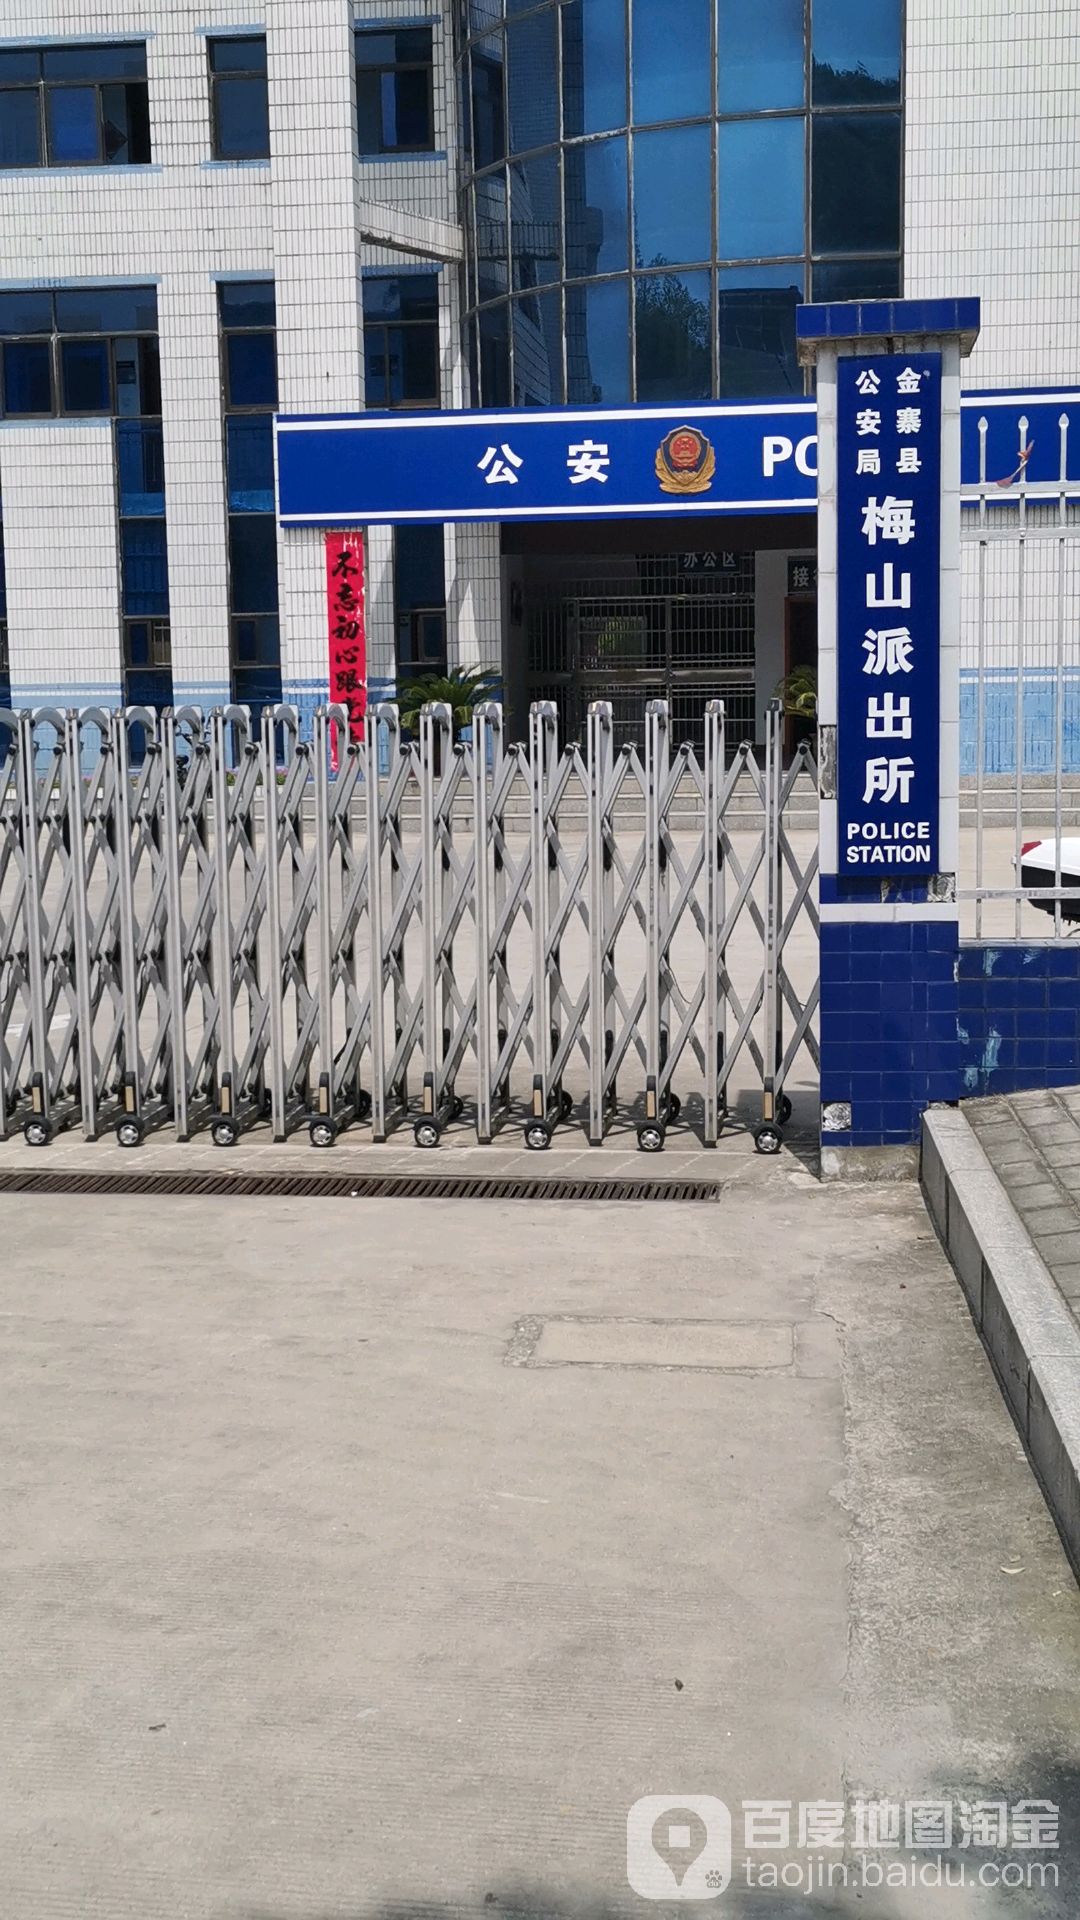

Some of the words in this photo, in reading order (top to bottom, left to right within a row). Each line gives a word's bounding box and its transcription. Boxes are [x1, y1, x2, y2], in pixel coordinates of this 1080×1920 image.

[855, 368, 882, 476] 公安局
[896, 366, 922, 474] 金寨县
[476, 439, 611, 485] 公安
[683, 551, 738, 569] 办公区
[792, 566, 818, 587] 接
[861, 495, 916, 804] 梅山派出所
[847, 822, 930, 840] POLICE
[846, 845, 931, 864] STATION
